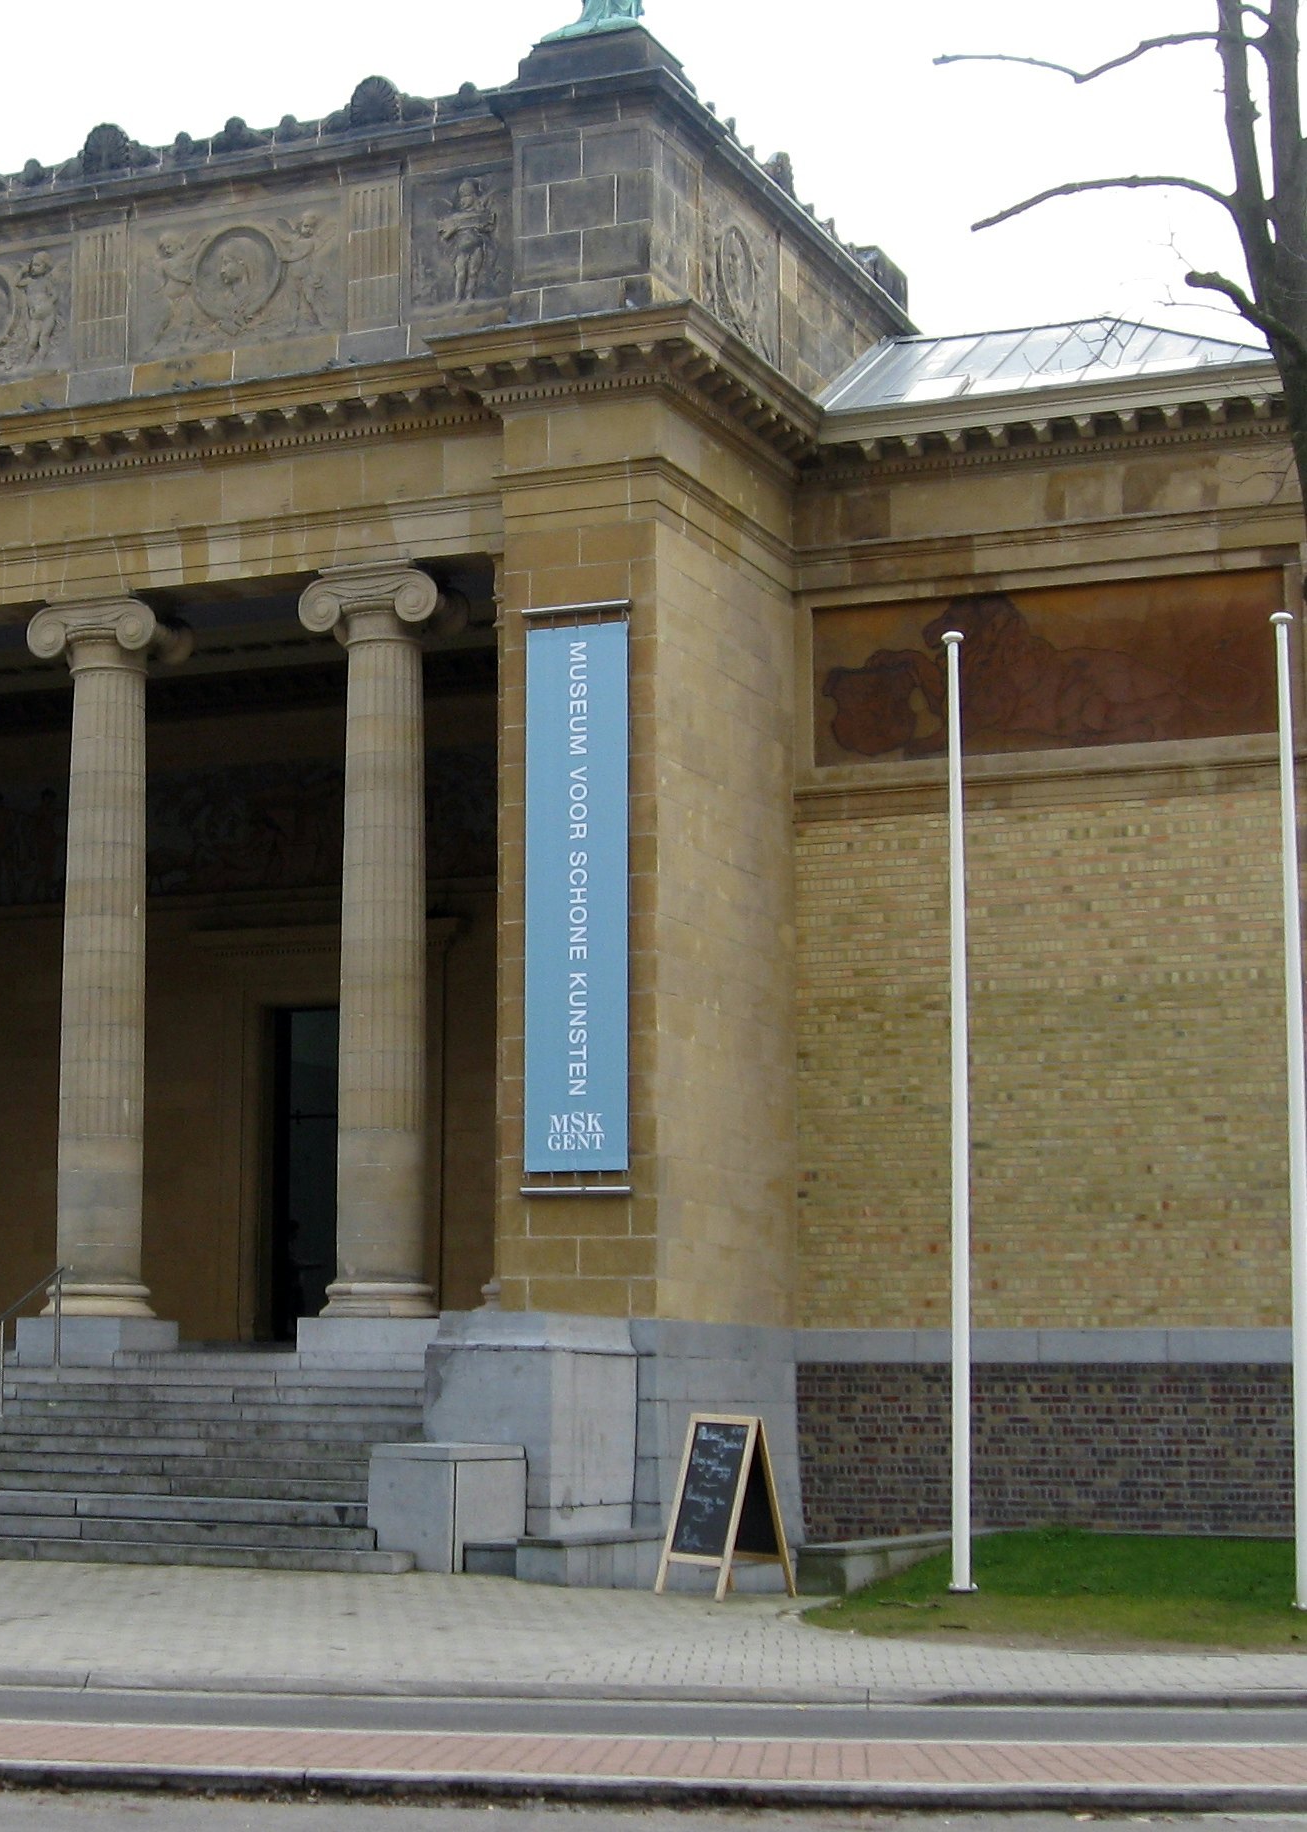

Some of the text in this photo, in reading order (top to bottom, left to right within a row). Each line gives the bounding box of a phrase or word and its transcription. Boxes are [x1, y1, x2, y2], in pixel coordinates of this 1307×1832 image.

[568, 641, 588, 1096] MUSEUM VOOR SCHONE KUNSTEN
[550, 1112, 604, 1133] MSK
[547, 1132, 606, 1151] GENT
